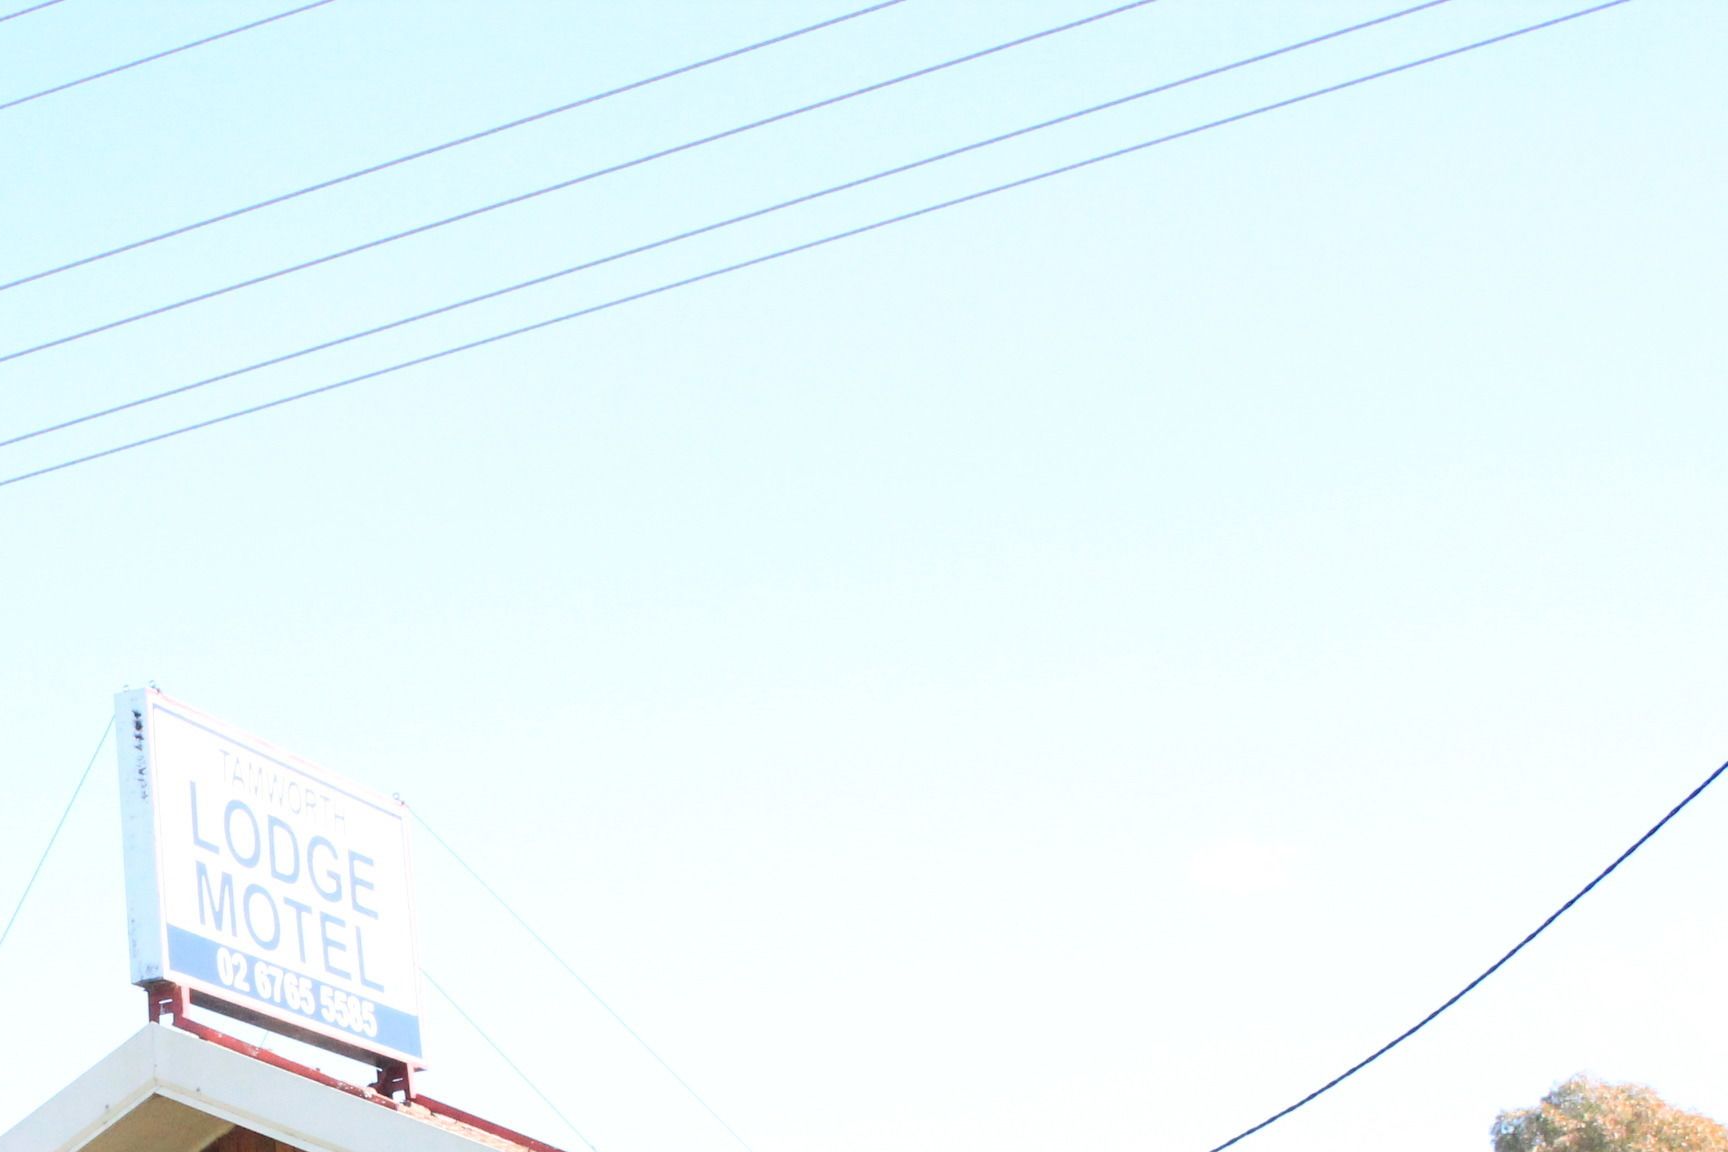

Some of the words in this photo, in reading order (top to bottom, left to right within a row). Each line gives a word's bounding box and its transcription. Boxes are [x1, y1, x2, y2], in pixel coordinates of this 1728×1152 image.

[218, 748, 347, 836] TAMWORTH
[189, 780, 380, 920] LODGE
[195, 860, 385, 994] MOTEL
[215, 947, 250, 994] 02
[254, 960, 315, 1016] 6765
[320, 984, 378, 1038] 5585
